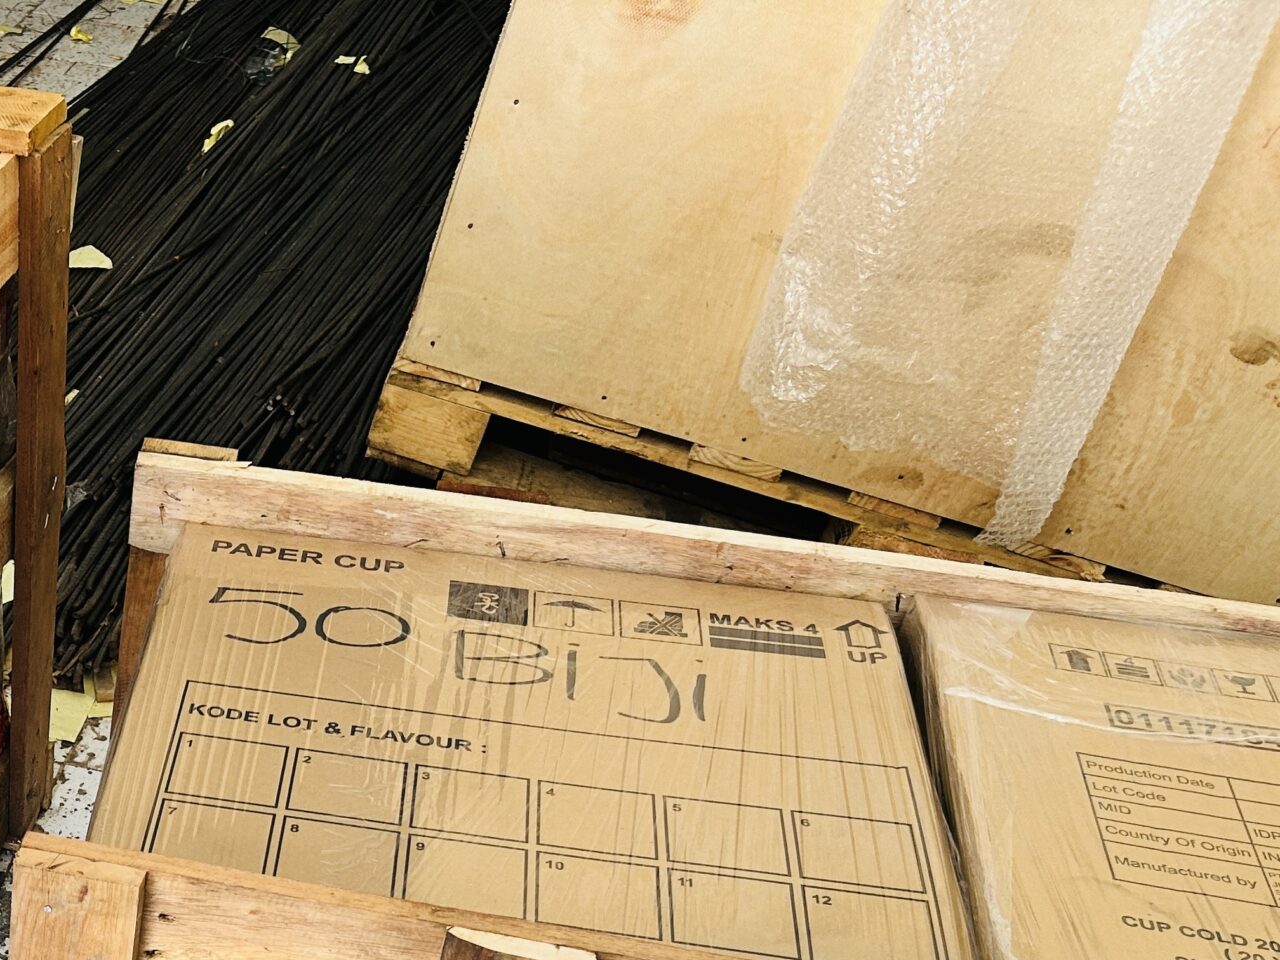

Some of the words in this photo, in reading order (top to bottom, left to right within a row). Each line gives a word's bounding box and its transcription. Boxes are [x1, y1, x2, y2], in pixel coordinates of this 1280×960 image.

[211, 539, 323, 565] PAPER
[333, 554, 406, 574] CUP
[208, 586, 412, 648] 50
[708, 611, 796, 633] MAKS
[803, 622, 820, 636] 4
[847, 649, 888, 665] UP
[187, 702, 260, 724] KODE
[267, 713, 319, 731] LOT
[323, 721, 343, 736] &
[349, 724, 473, 752] FLAVOUR
[186, 739, 194, 749] 1
[302, 754, 313, 765] 2
[421, 770, 432, 781] 3
[1085, 760, 1172, 783] Production
[1176, 775, 1216, 790] Date
[545, 787, 556, 798] 4
[1091, 781, 1119, 794] Lot
[1122, 786, 1166, 801] Code
[167, 806, 178, 816] 7
[671, 803, 683, 813] 5
[1097, 801, 1132, 815] MID
[289, 823, 300, 834] 8
[800, 818, 811, 828] 6
[415, 841, 426, 852] 9
[1104, 824, 1171, 846] Country
[1175, 837, 1197, 849] Of
[1200, 840, 1252, 858] Origin
[1262, 851, 1280, 862] IN
[545, 859, 565, 872] 10
[1113, 855, 1232, 883] Manufactured
[1235, 876, 1257, 890] by
[677, 876, 694, 888] 11
[811, 894, 833, 906] 12
[1121, 915, 1172, 933] CUP
[1178, 925, 1248, 946] COLD
